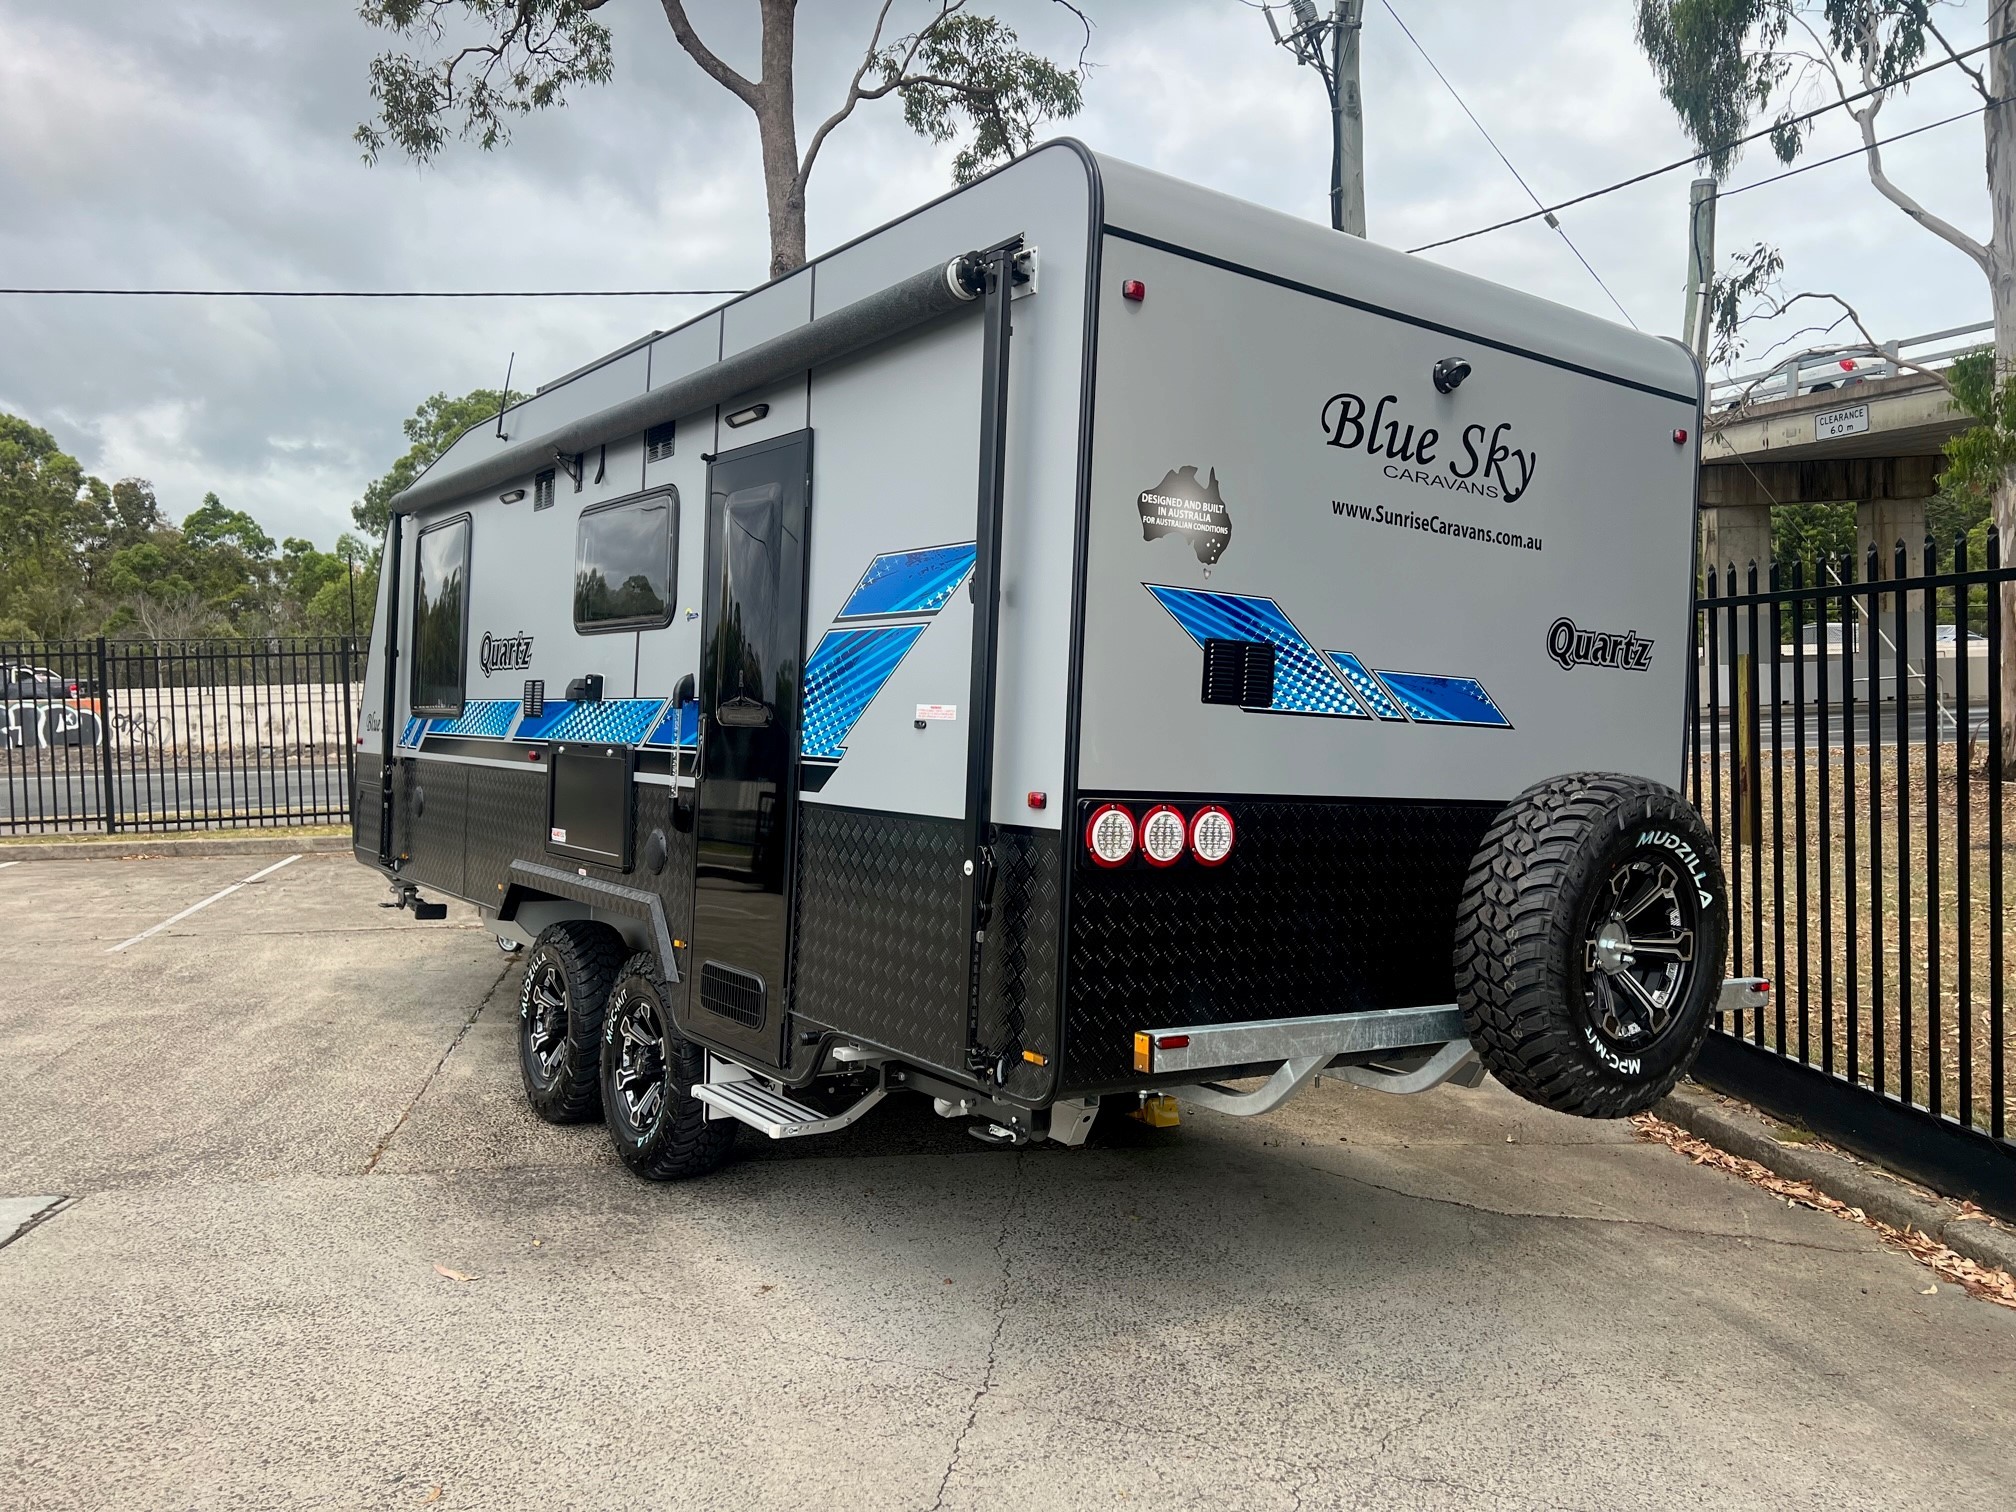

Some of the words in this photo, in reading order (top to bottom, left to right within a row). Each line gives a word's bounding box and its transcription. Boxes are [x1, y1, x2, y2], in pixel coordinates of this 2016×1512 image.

[1819, 408, 1864, 426] CLEARANCE
[1830, 424, 1844, 434] 6.0
[1321, 393, 1439, 465] Blue
[1449, 423, 1537, 503] Sky
[1383, 465, 1499, 499] CARAVANS
[1141, 492, 1183, 507] DESIGNED
[1183, 499, 1202, 510] AND
[1202, 502, 1225, 514] BUILT
[1157, 506, 1167, 516] IN
[1167, 508, 1212, 523] AUSTRALIA
[1142, 515, 1156, 524] FOR
[1155, 517, 1193, 530] AUSTRALIAN
[1193, 523, 1229, 535] CONDITIONS
[1331, 500, 1543, 551] www.SunriseCaravans.com.au
[480, 630, 534, 678] Quartz
[1546, 616, 1655, 672] Quartz
[1635, 830, 1713, 909] MUDZILLA
[520, 952, 547, 1019] MUDZILLA
